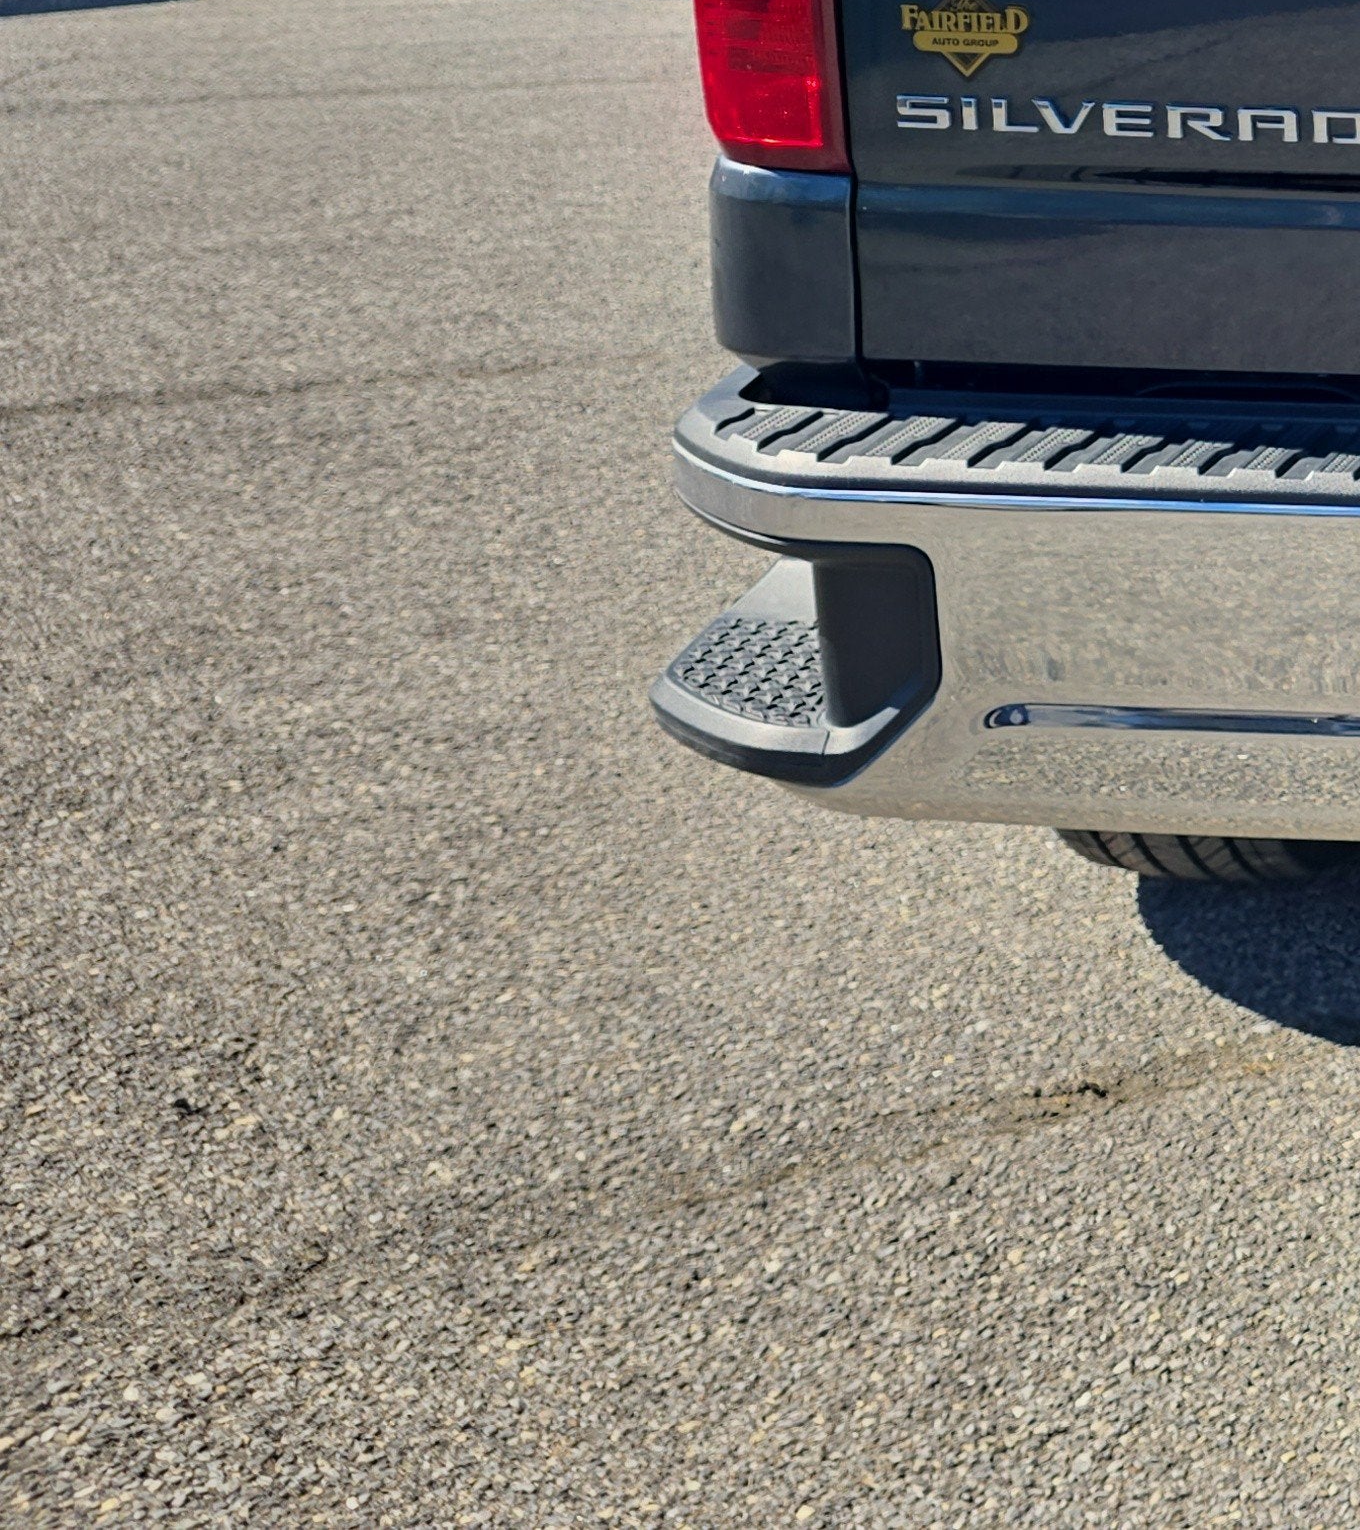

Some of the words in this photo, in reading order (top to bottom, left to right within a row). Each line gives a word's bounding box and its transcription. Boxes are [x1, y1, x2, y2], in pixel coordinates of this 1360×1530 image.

[900, 3, 1029, 34] FAIRFIELD
[931, 37, 959, 47] AUTO
[962, 39, 999, 48] GROUP
